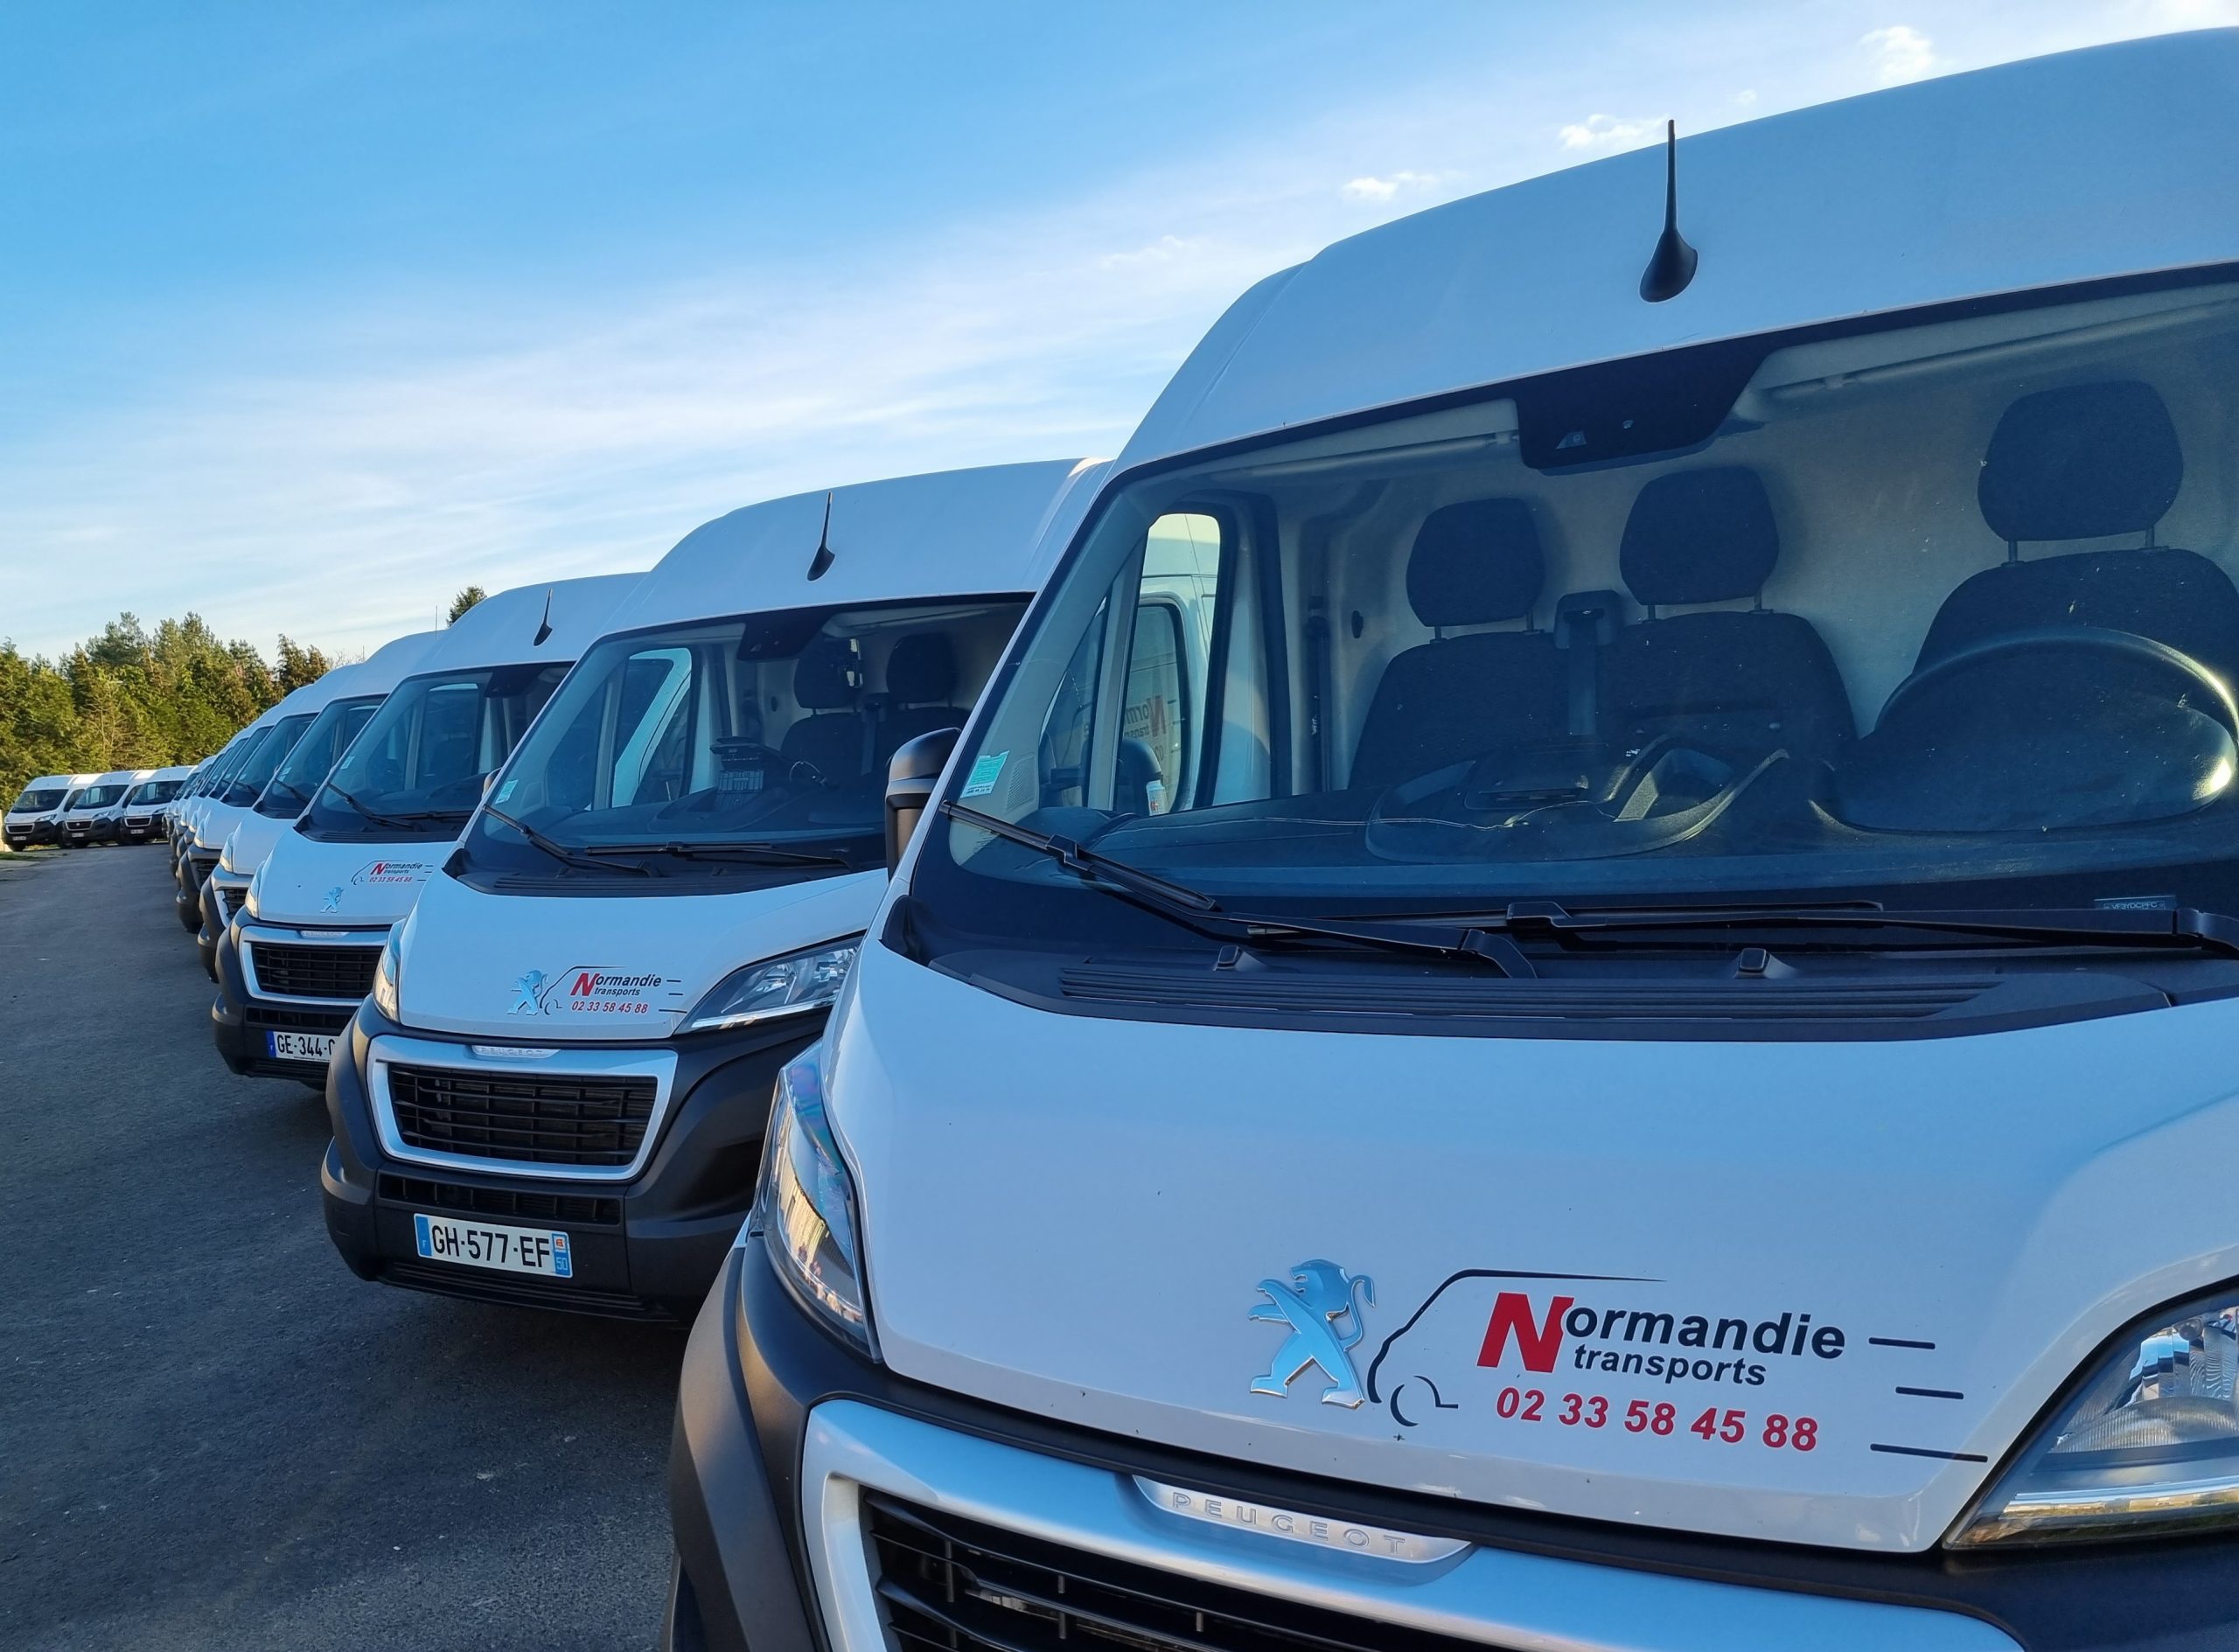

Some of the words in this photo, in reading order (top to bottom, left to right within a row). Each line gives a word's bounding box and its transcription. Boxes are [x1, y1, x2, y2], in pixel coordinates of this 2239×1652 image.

[370, 862, 423, 875] Normandie
[569, 972, 662, 997] Normandie
[595, 987, 641, 997] transports
[571, 1000, 585, 1011] 02
[587, 1001, 601, 1012] 33
[603, 1002, 617, 1013] 58
[617, 1003, 632, 1014] 45
[634, 1003, 648, 1014] 88
[431, 1224, 551, 1268] GH-577-EF
[555, 1257, 568, 1272] 50
[1476, 1292, 1846, 1374] Normandie
[1573, 1343, 1768, 1386] transports
[1496, 1386, 1545, 1423] 02
[1558, 1392, 1609, 1429] 33
[1623, 1399, 1678, 1436] 58
[1690, 1407, 1747, 1444] 45
[1761, 1413, 1819, 1453] 88
[1171, 1490, 1405, 1556] PEUGEOT
